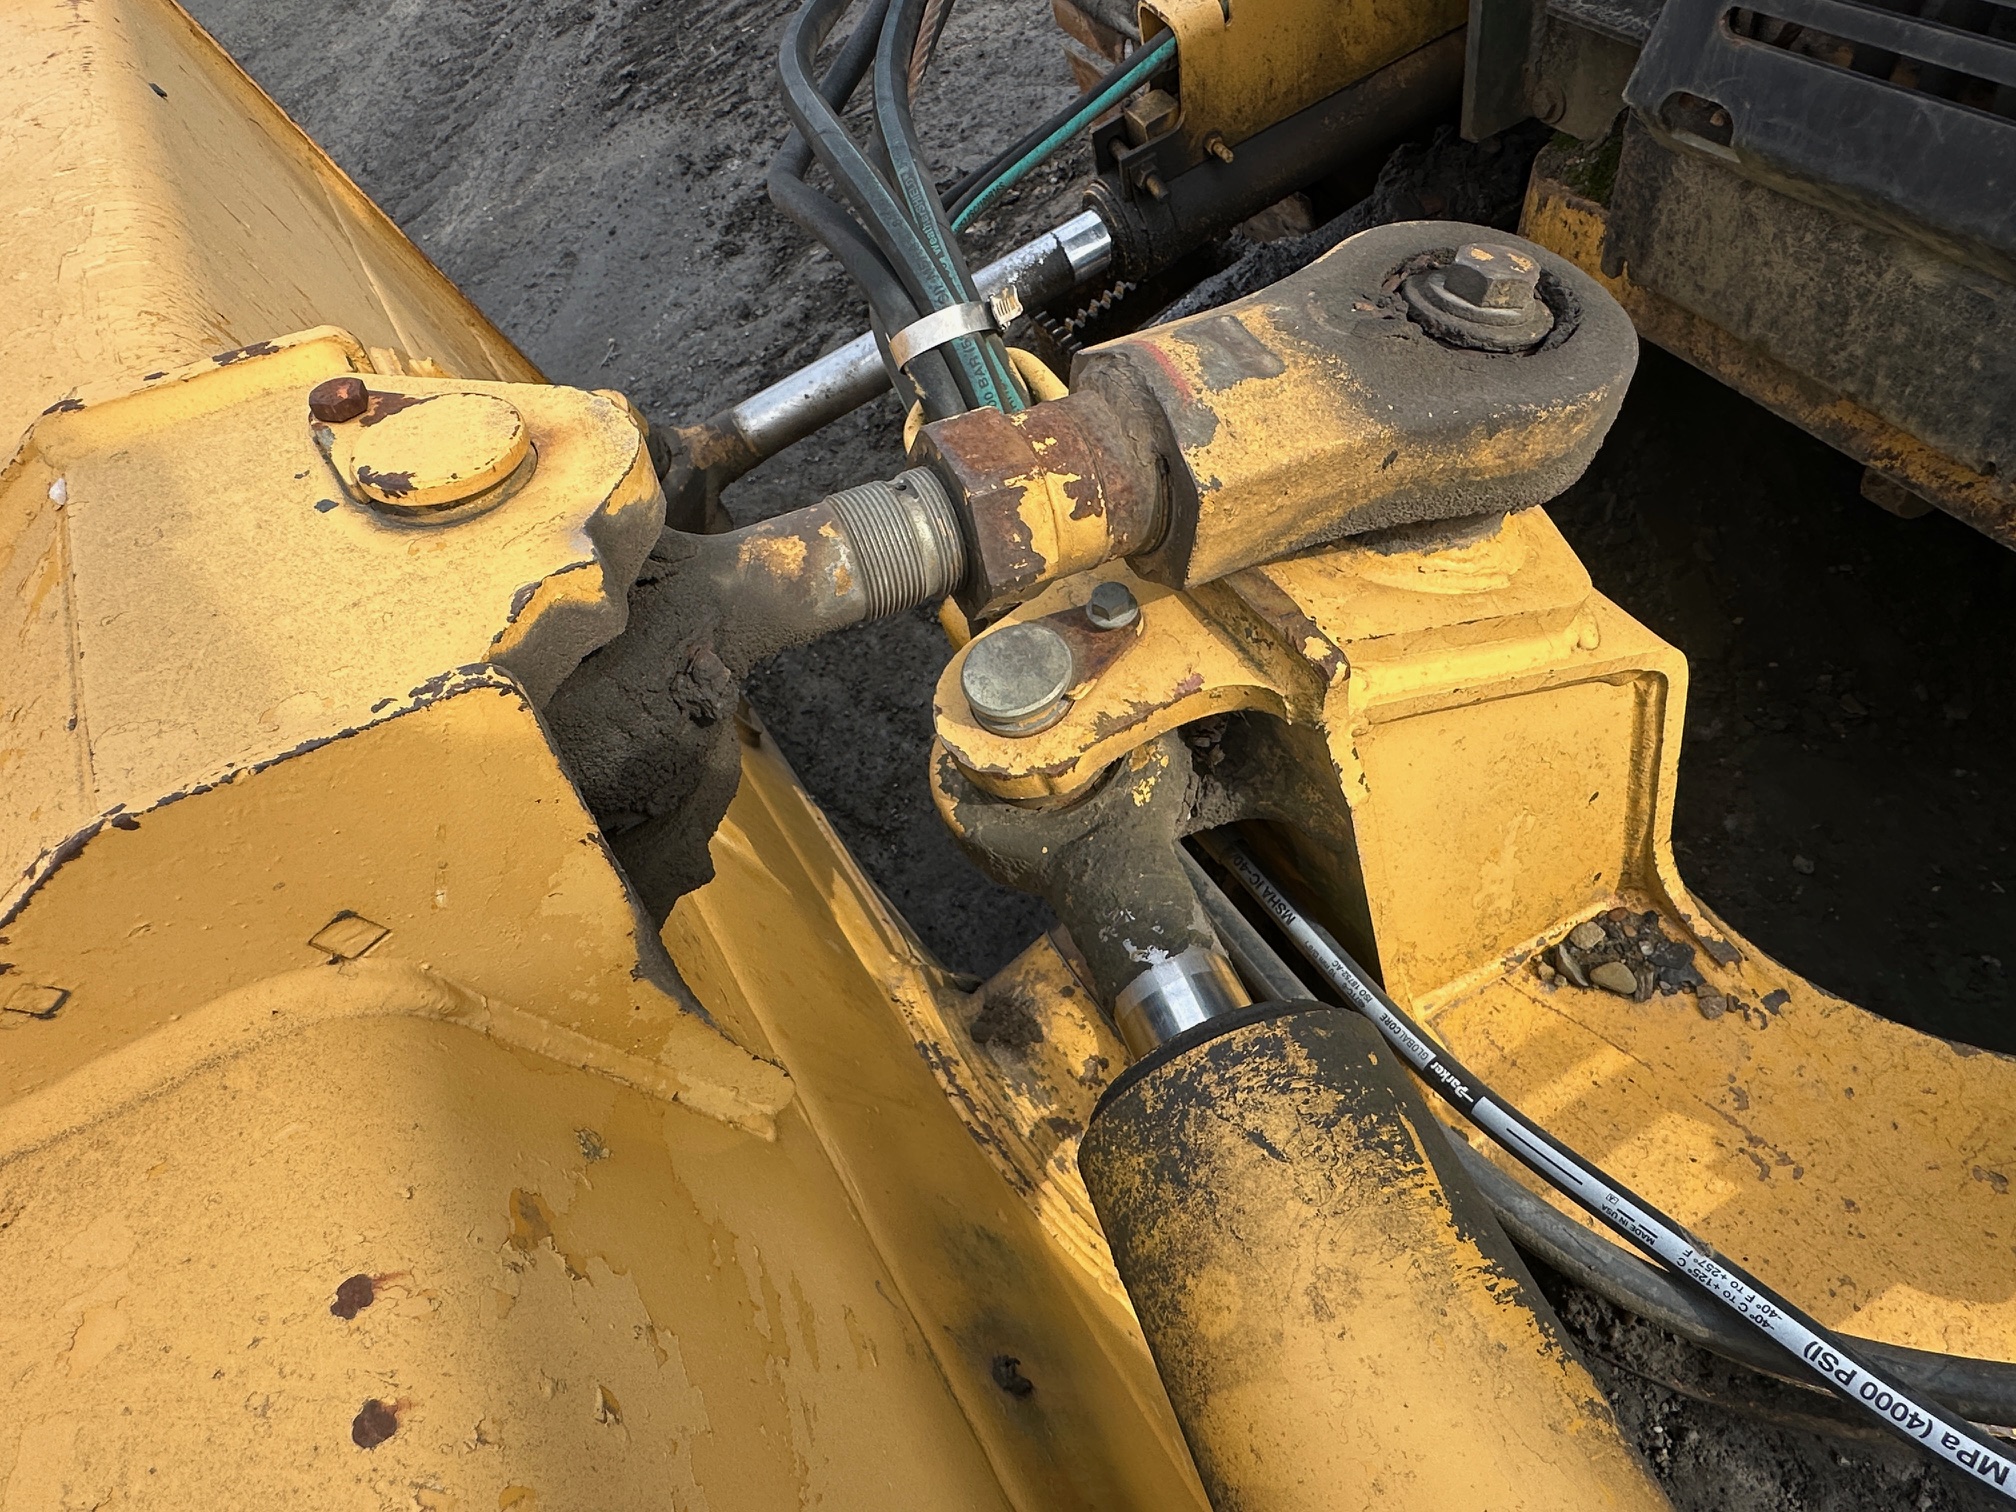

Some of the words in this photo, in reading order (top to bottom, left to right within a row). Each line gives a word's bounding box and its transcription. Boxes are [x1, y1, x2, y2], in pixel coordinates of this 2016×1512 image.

[969, 355, 989, 390] BAR
[1262, 886, 1296, 925] MSHA
[1331, 960, 1360, 990] 18752-AC
[1359, 989, 1373, 1003] ISO
[1430, 1061, 1470, 1099] Parker
[1601, 1203, 1619, 1219] USA
[1618, 1216, 1629, 1227] IN
[1629, 1224, 1656, 1246] MADE
[1676, 1257, 1687, 1267] C
[1682, 1249, 1693, 1258] F
[1693, 1258, 1728, 1280] +257°
[1687, 1267, 1720, 1290] +125°
[1730, 1280, 1744, 1295] TO
[1722, 1290, 1736, 1304] TO
[1744, 1294, 1756, 1303] F
[1737, 1302, 1749, 1313] C
[1755, 1304, 1783, 1321] -40°
[1749, 1313, 1775, 1330] -40°
[1803, 1341, 1858, 1386] PSI)
[1859, 1381, 1933, 1439] (4000
[1941, 1431, 2010, 1486] MPa
